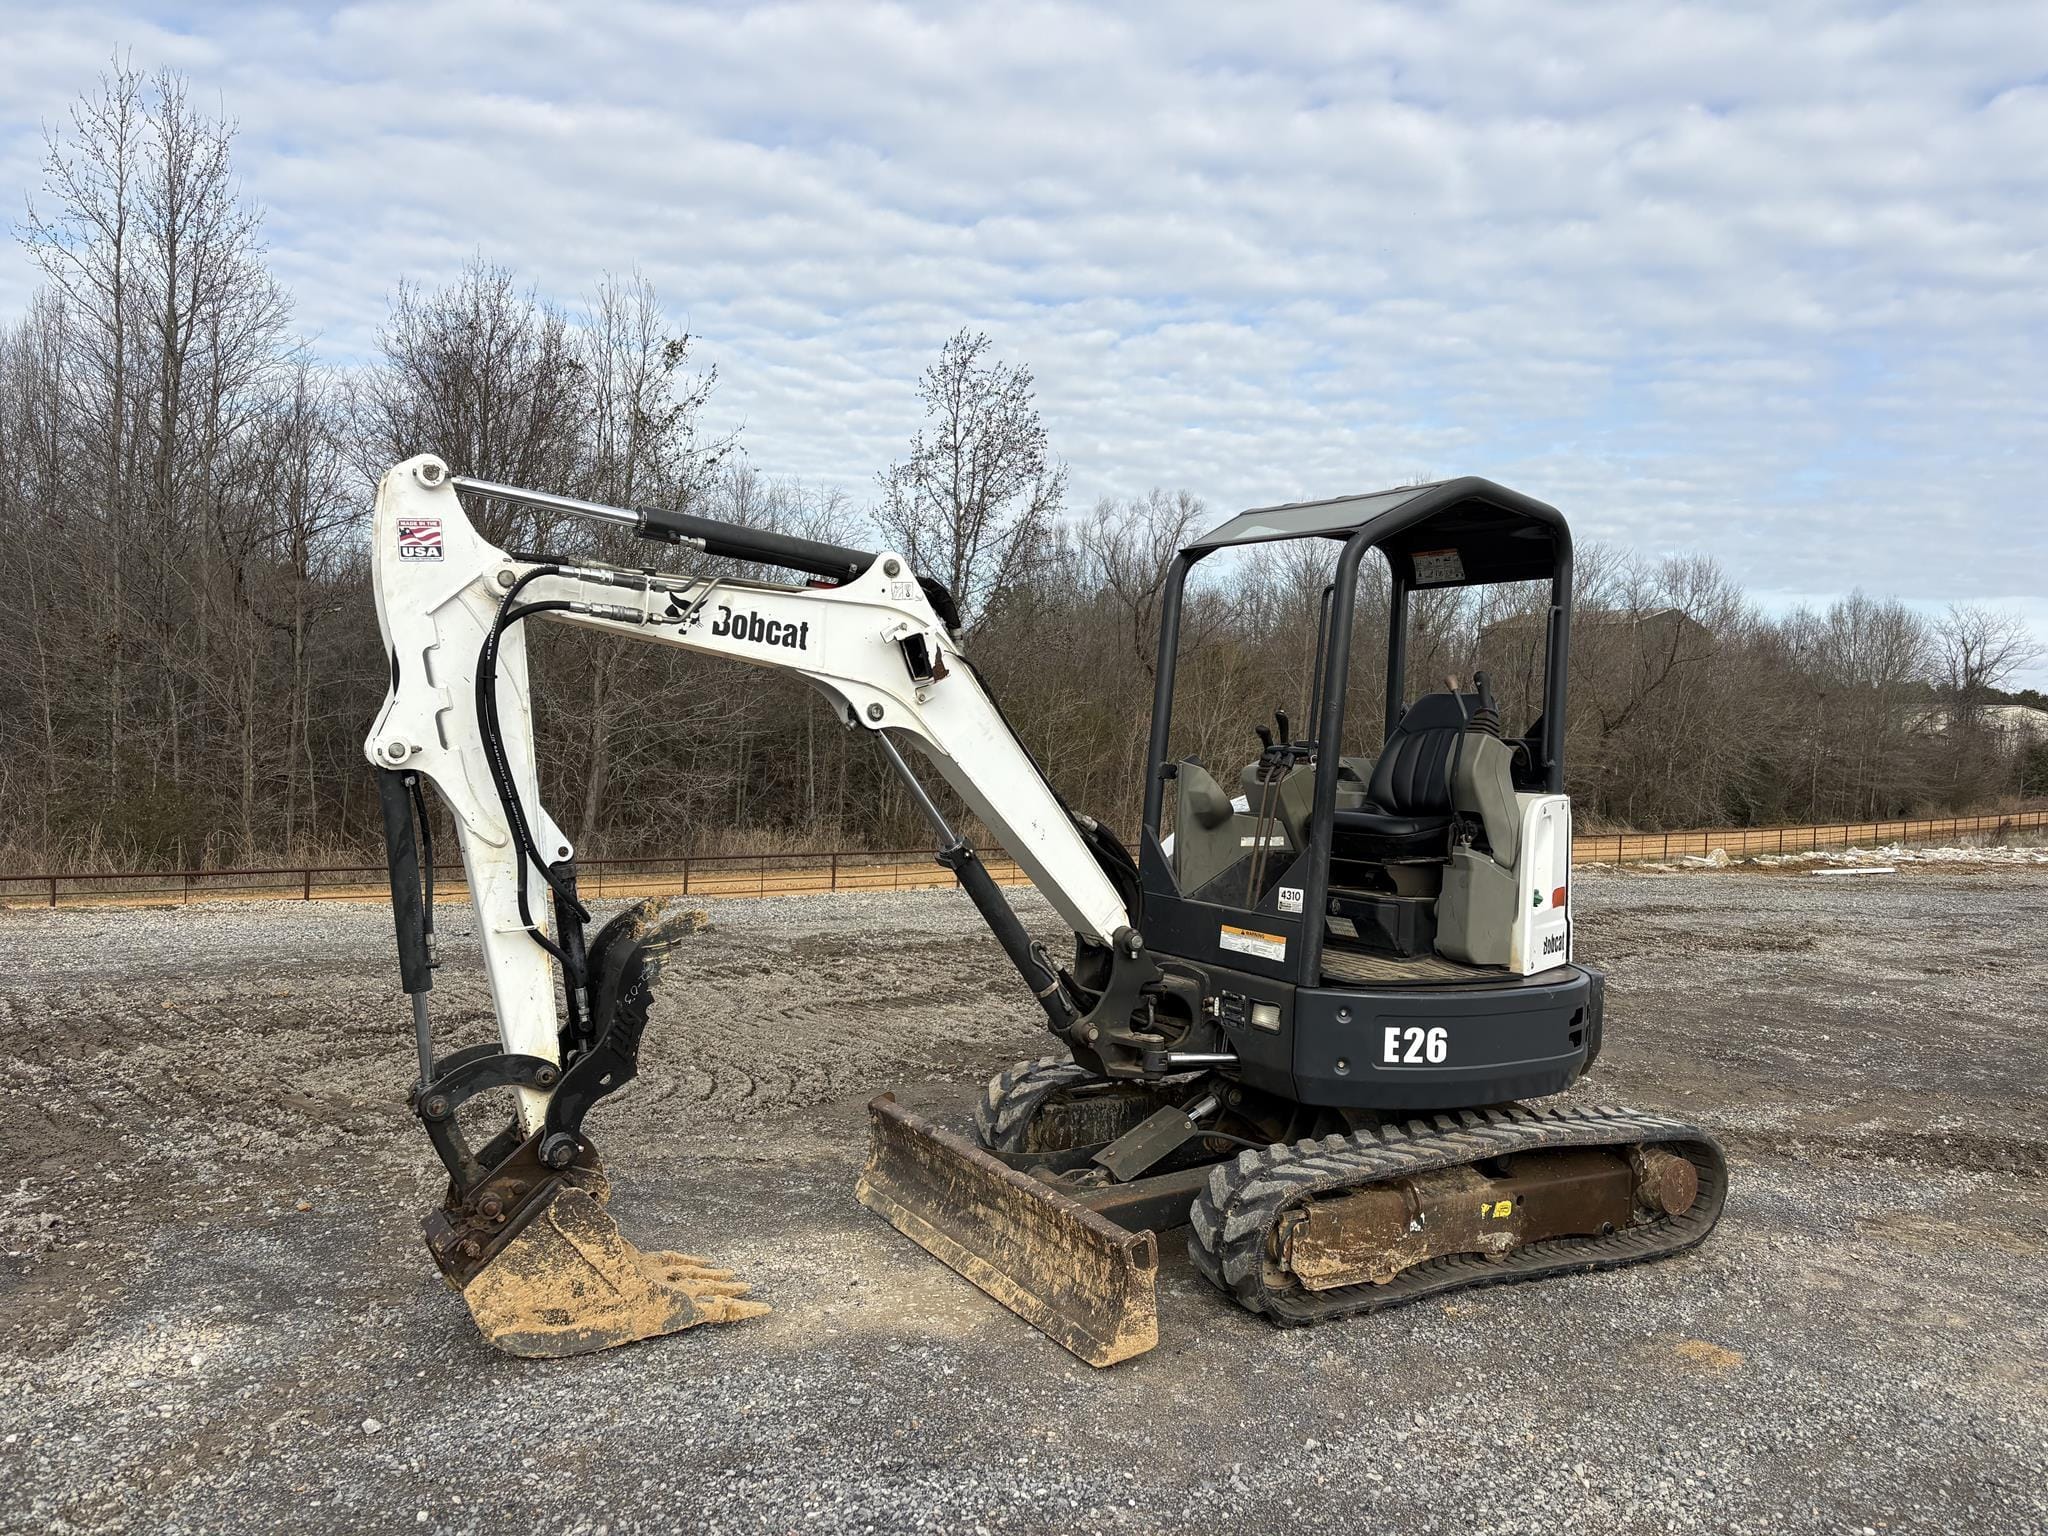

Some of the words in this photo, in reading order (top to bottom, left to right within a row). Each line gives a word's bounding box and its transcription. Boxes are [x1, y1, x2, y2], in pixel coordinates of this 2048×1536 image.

[402, 547, 440, 557] USA
[712, 605, 809, 651] Bobcat
[1281, 890, 1301, 902] 4310
[1543, 931, 1565, 955] Bobcat
[1384, 1027, 1448, 1064] E26
